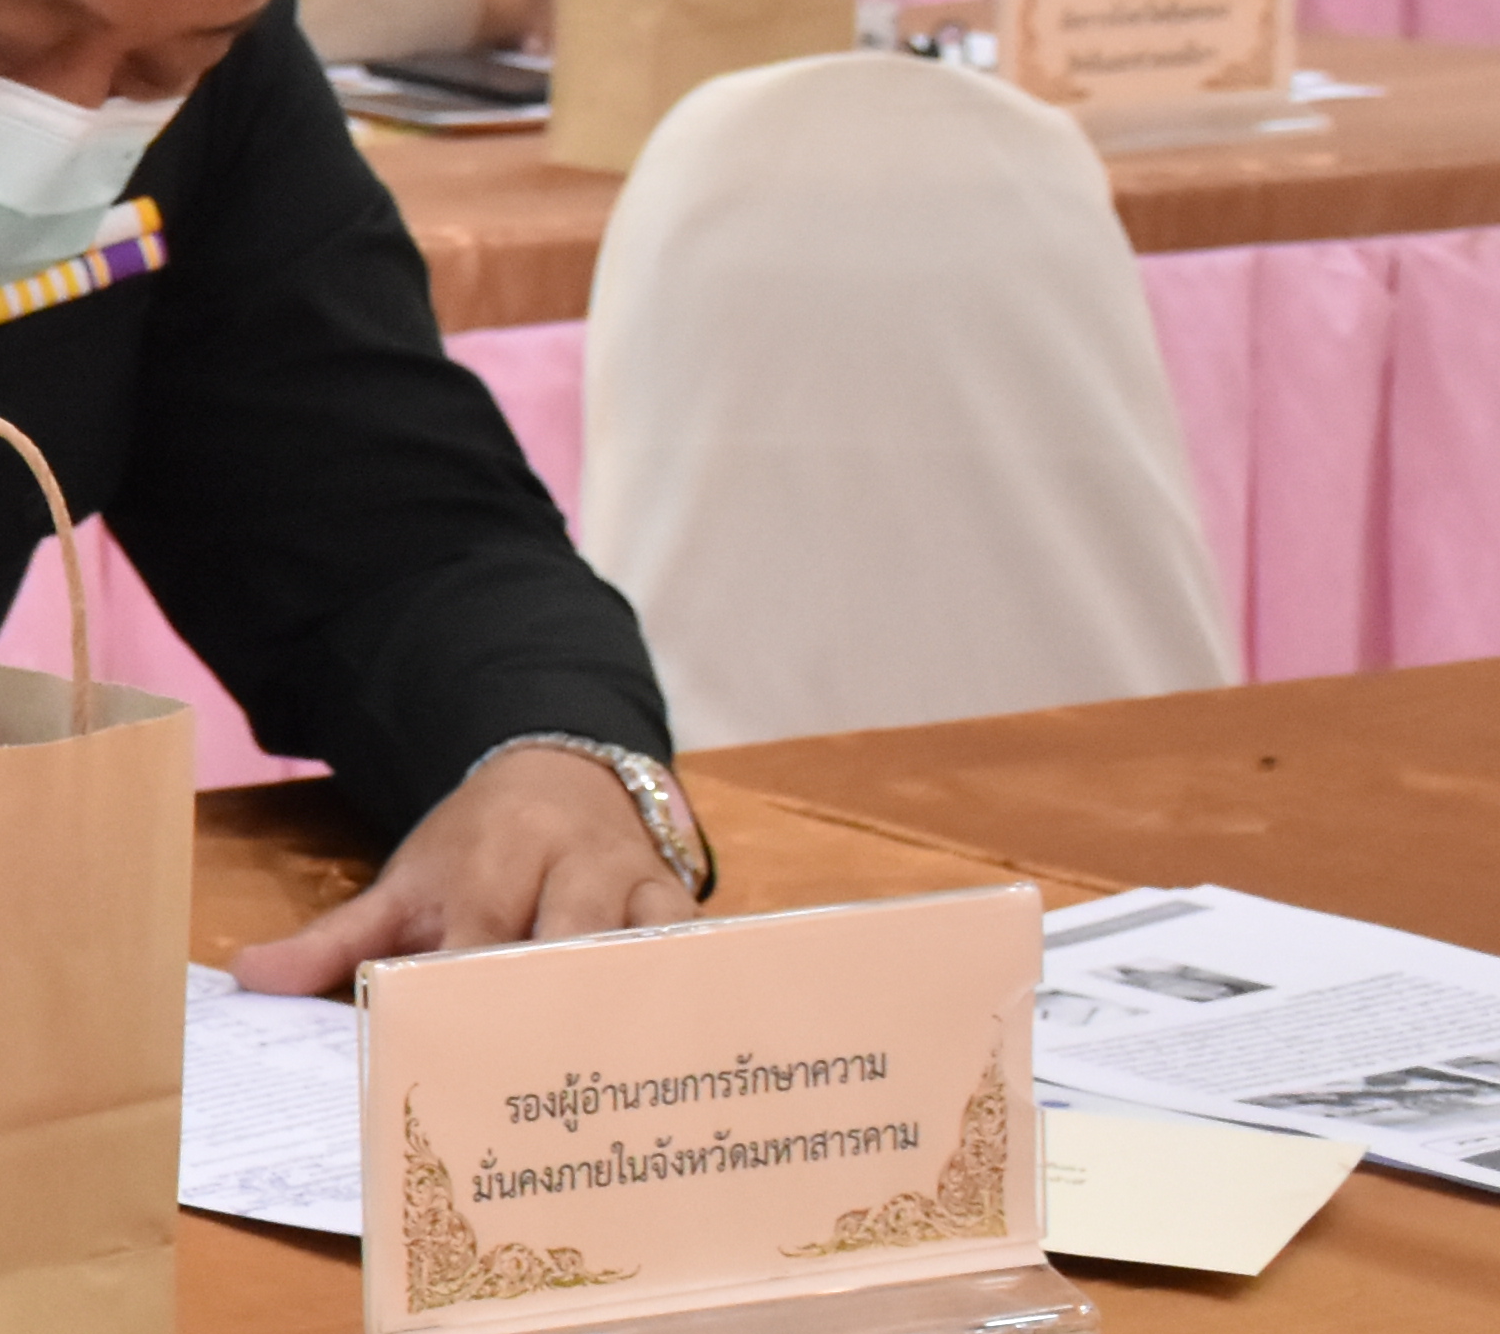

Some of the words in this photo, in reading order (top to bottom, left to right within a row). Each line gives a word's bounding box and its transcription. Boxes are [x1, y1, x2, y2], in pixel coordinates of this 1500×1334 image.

[505, 1052, 888, 1132] รองผู้อำนวยการรักษาความ
[471, 1120, 920, 1205] มั่นคงภายในจังหวัดมหาสารคาม
